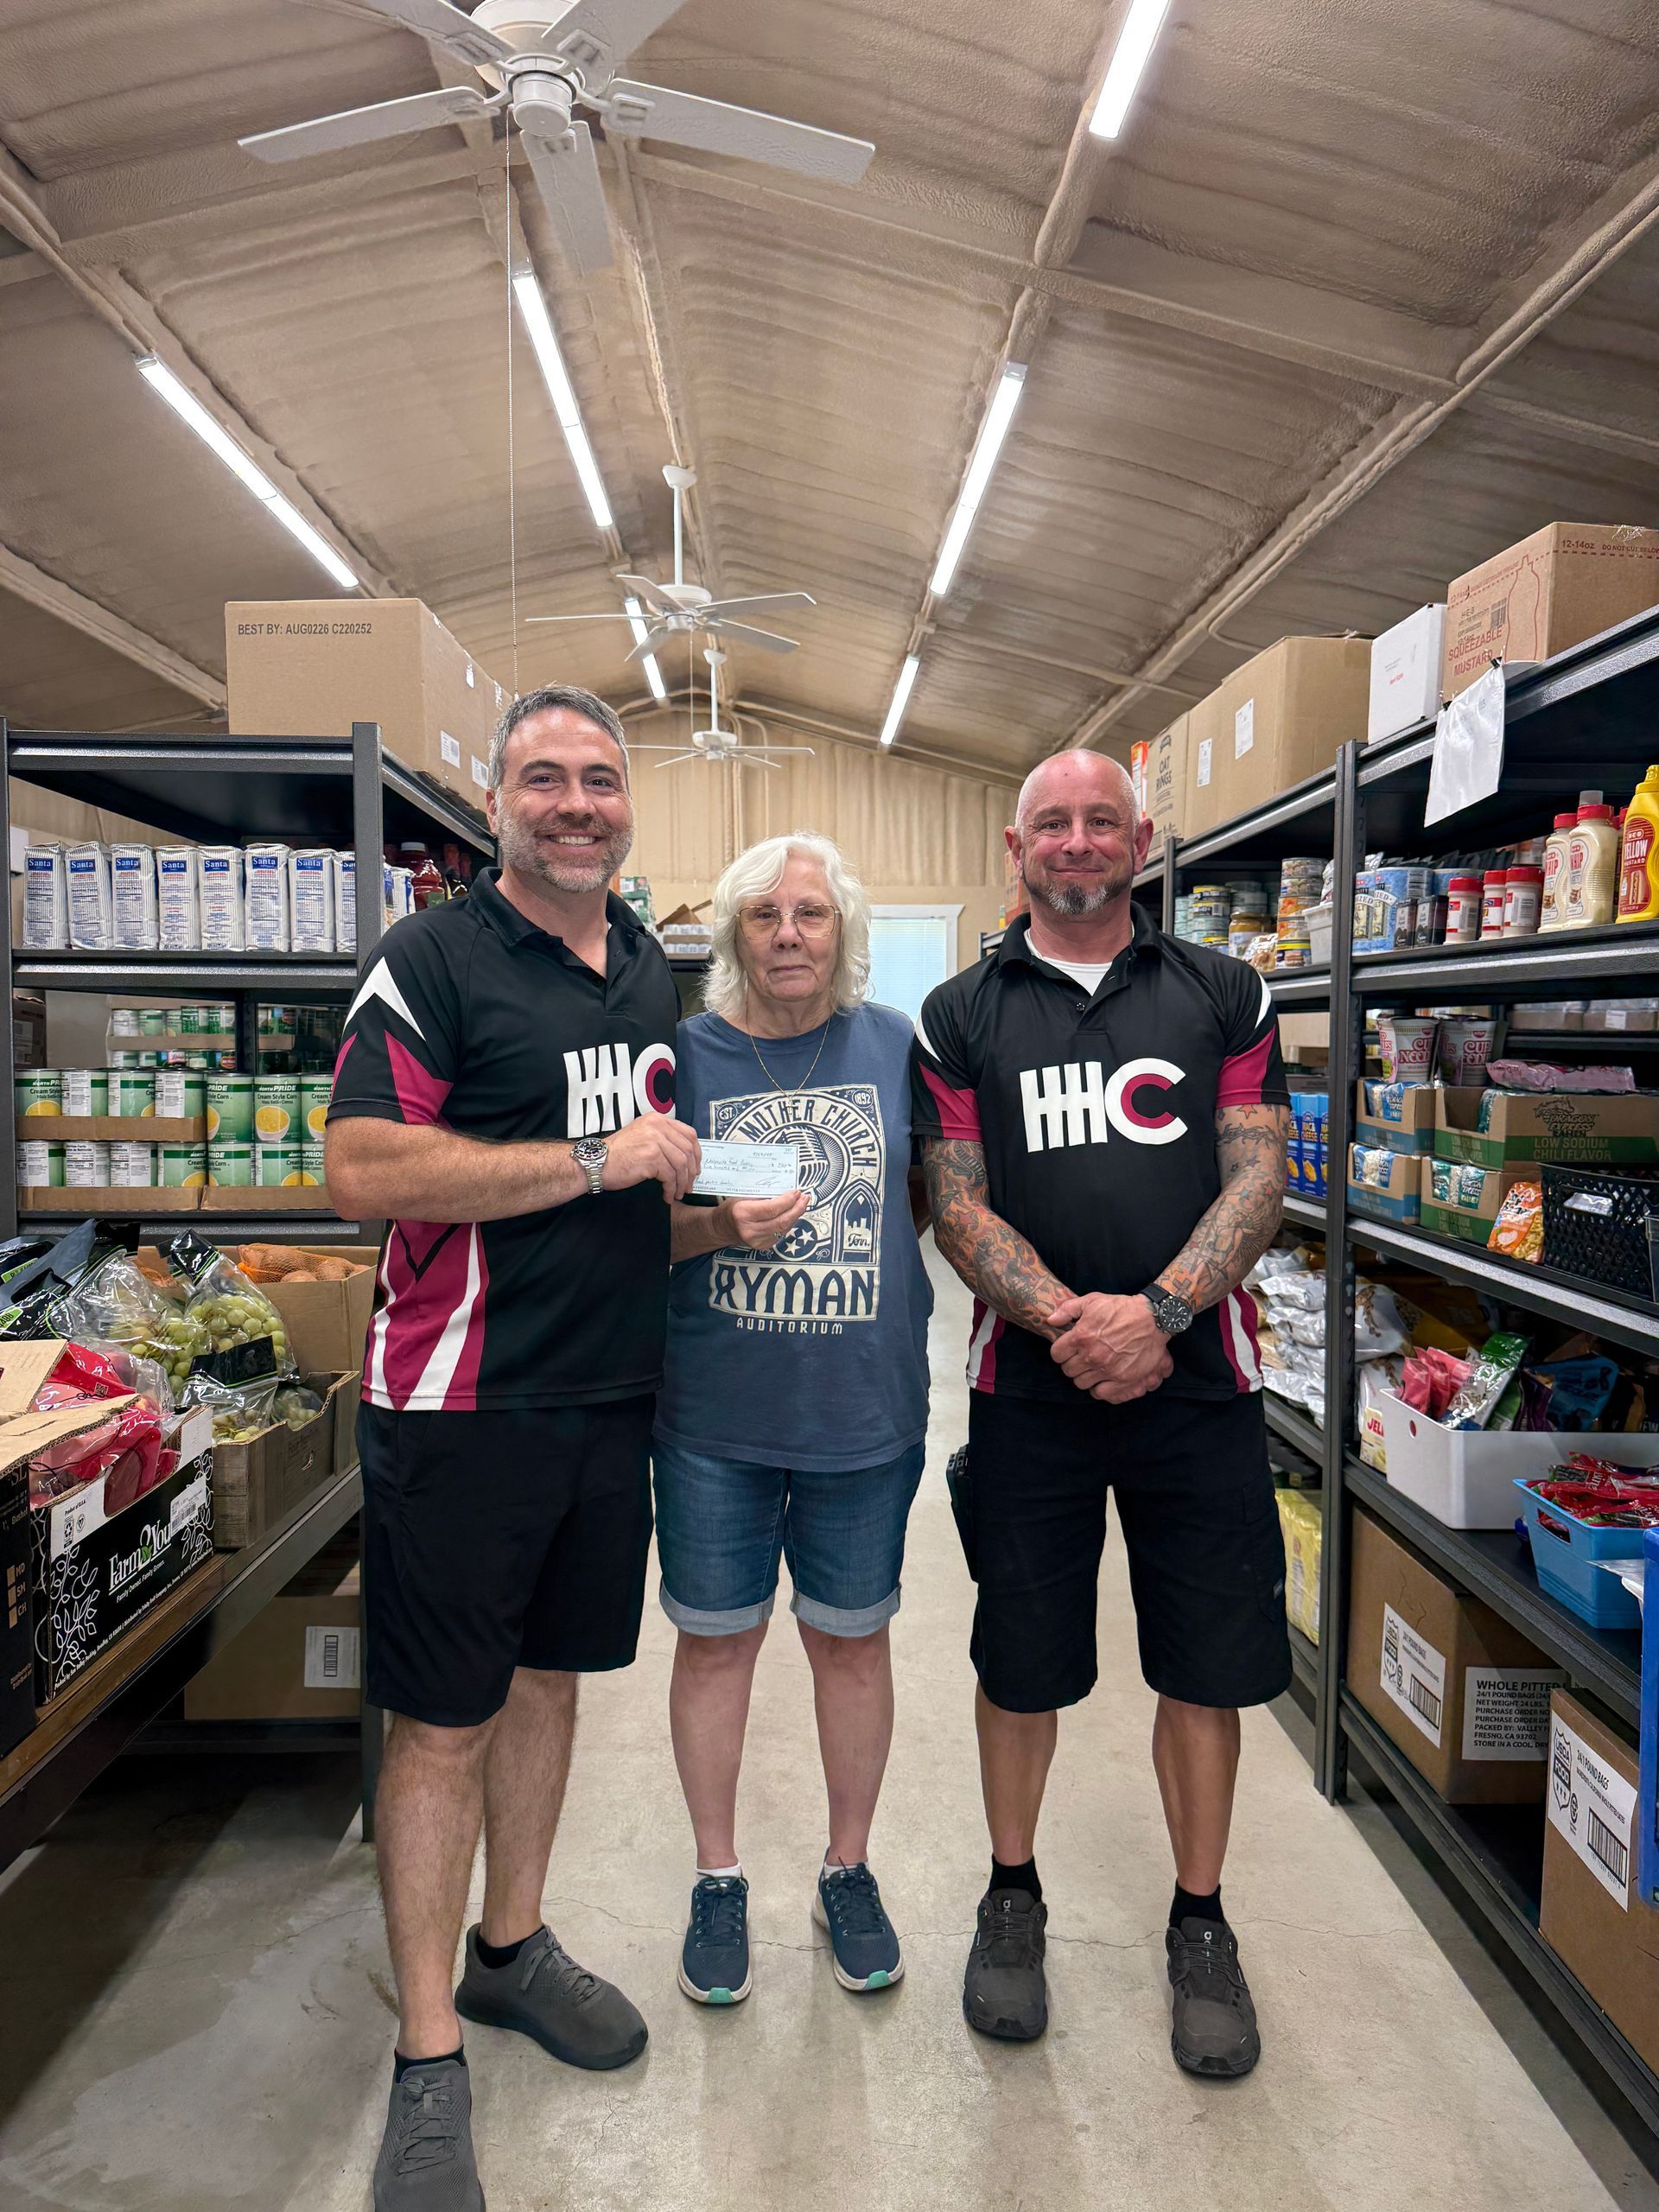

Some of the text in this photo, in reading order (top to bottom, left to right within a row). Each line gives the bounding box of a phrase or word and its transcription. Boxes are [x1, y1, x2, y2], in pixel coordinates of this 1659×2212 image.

[1562, 539, 1596, 550] 12-14oz
[238, 623, 372, 635] BEST BY: AUG0226 C220252
[1448, 625, 1503, 661] SQUEEZABLE
[1453, 650, 1493, 677] MUSTARD
[274, 1082, 296, 1092] PRIDE
[855, 1091, 872, 1105] 1892
[1019, 1058, 1188, 1154] HHC
[719, 1107, 735, 1120] EST.
[737, 1099, 878, 1167] MOTHER CHURCH
[1548, 1122, 1595, 1132] EXPRESS
[1534, 1137, 1609, 1148] LOW SODIUM
[1533, 1149, 1611, 1160] CHILI FLAVOR
[847, 1232, 871, 1247] Tenn.
[713, 1263, 875, 1316] RYMAN
[736, 1316, 843, 1335] AUDITORIUM
[117, 1591, 129, 1604] Family
[142, 1568, 154, 1584] Family
[1477, 1680, 1560, 1692] WHOLE PITTED
[1555, 1738, 1570, 1761] USDA
[1555, 1762, 1570, 1783] FOOD
[1585, 1756, 1598, 1778] POUND
[1598, 1770, 1610, 1791] BAGS
